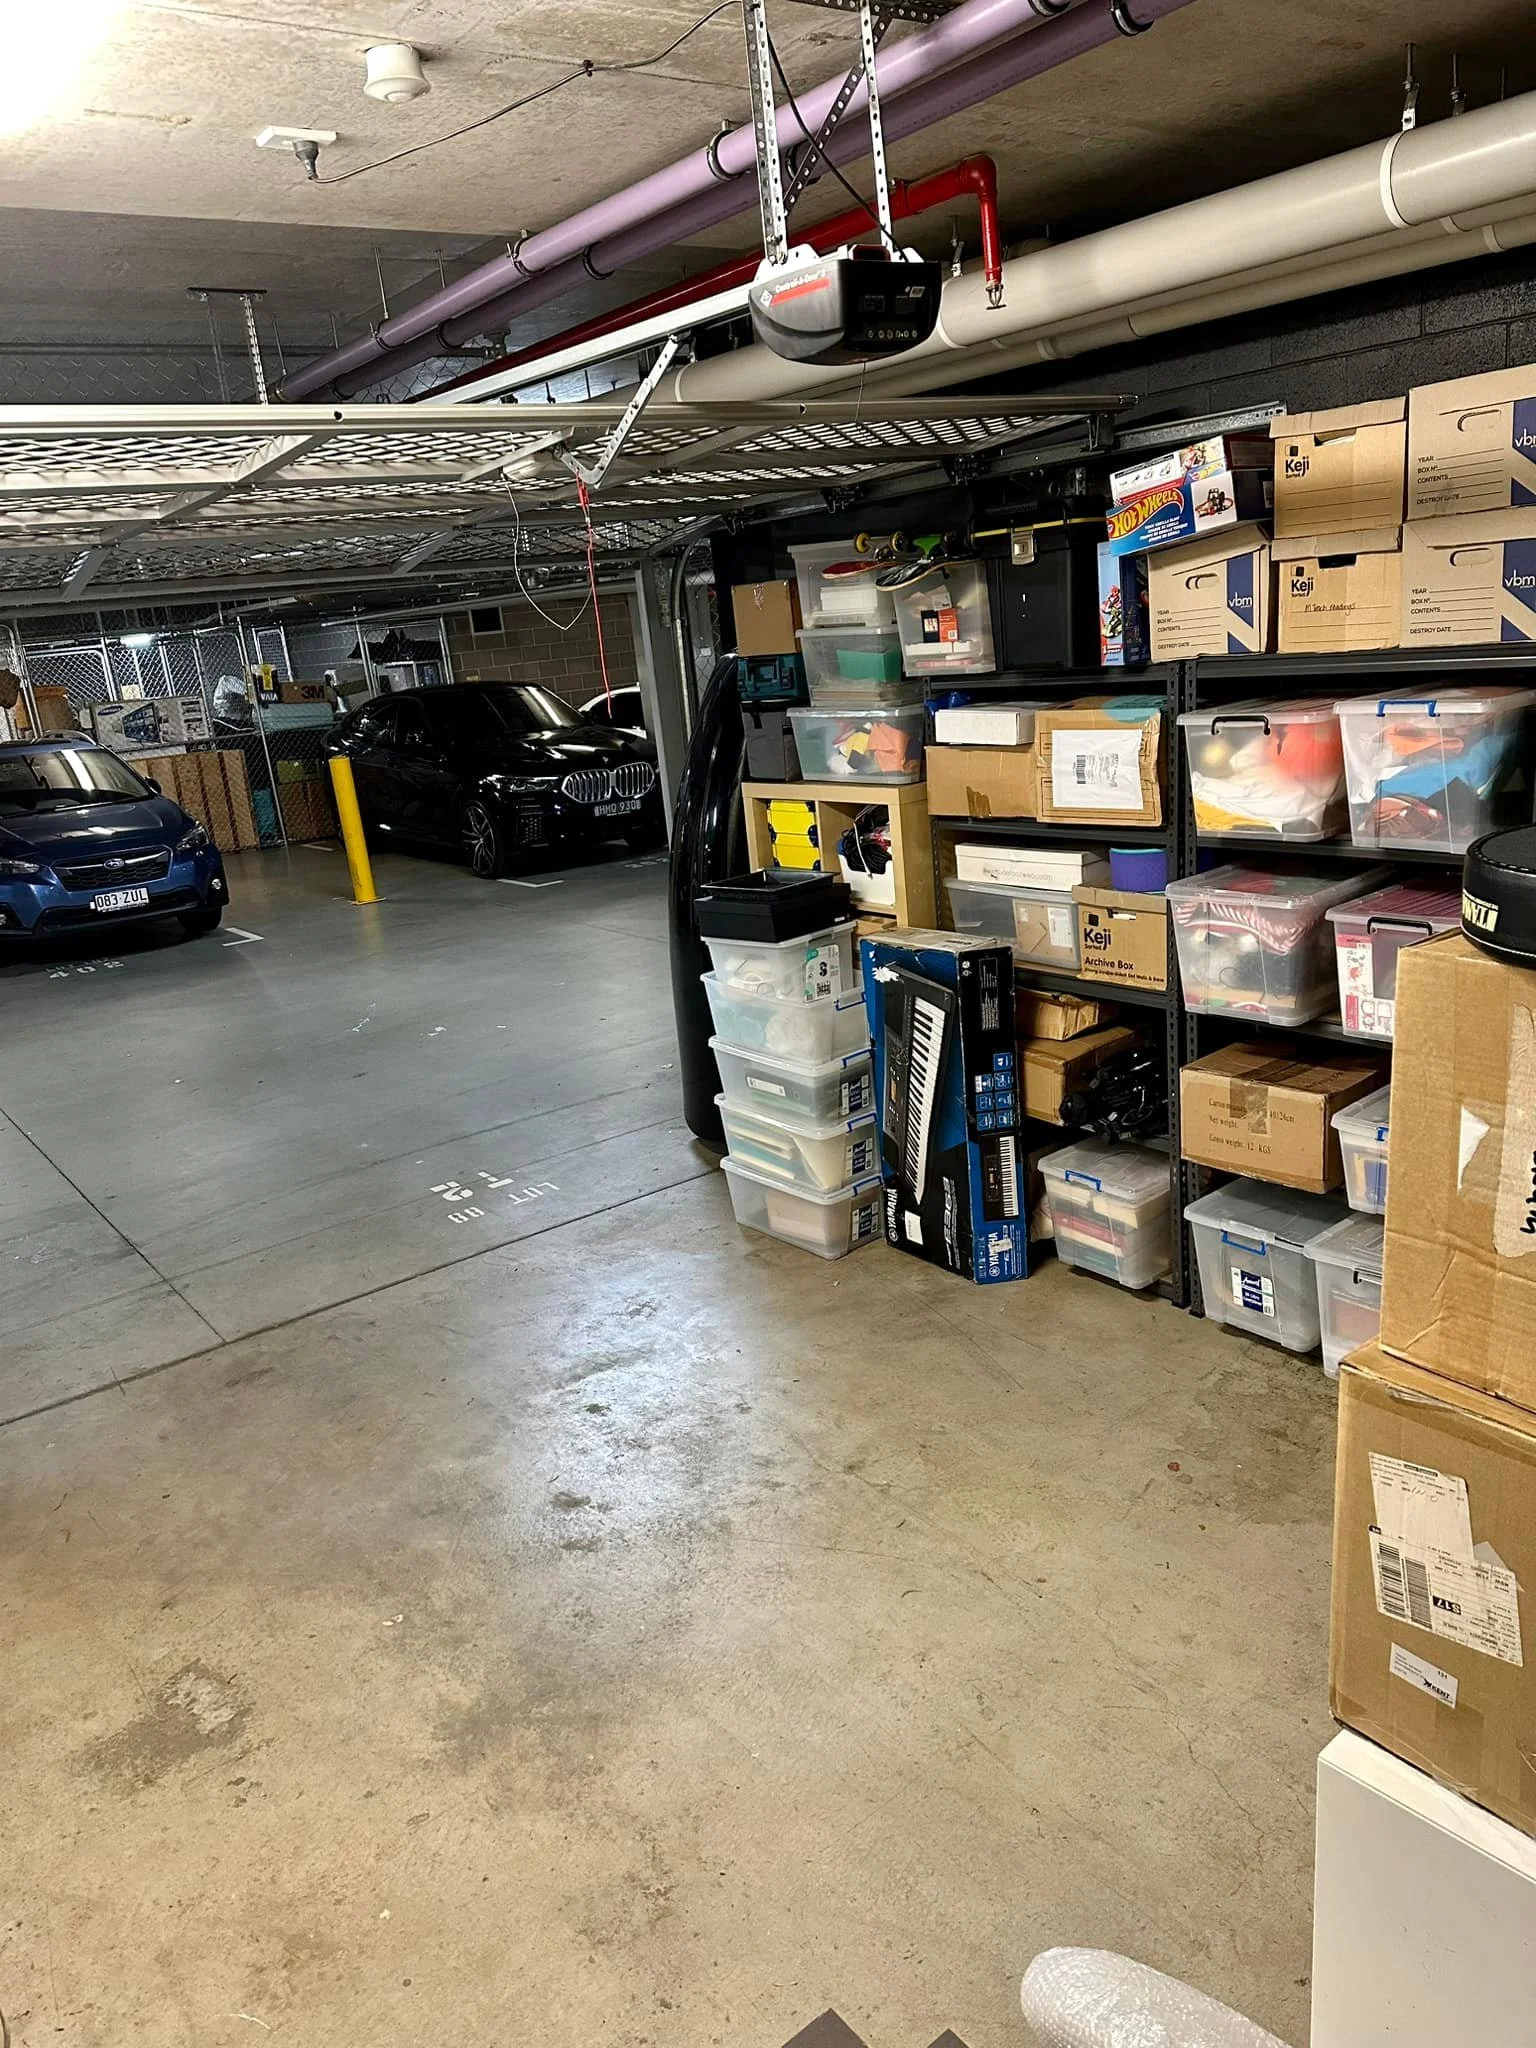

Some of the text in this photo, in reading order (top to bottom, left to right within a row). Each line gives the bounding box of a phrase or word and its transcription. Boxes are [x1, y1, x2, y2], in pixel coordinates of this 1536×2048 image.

[1285, 456, 1310, 477] Keji
[1417, 474, 1448, 484] CONTENTS
[1416, 496, 1442, 504] DESTROY
[1112, 508, 1138, 537] HOT
[1291, 577, 1314, 596] Keji
[1505, 570, 1535, 587] vbm
[1229, 592, 1253, 608] vbm
[1411, 607, 1441, 615] CONTENTS
[1410, 627, 1435, 635] DESTROY
[302, 685, 325, 698] 3M
[96, 890, 147, 908] 083 ZUL
[1084, 928, 1112, 951] Keji
[1085, 957, 1134, 970] Archive Box
[1259, 1144, 1271, 1154] KGS
[508, 1182, 560, 1205] LOT
[886, 1188, 898, 1229] YAMAHA
[988, 1231, 1000, 1267] YAMHA
[1435, 1597, 1461, 1614] S17
